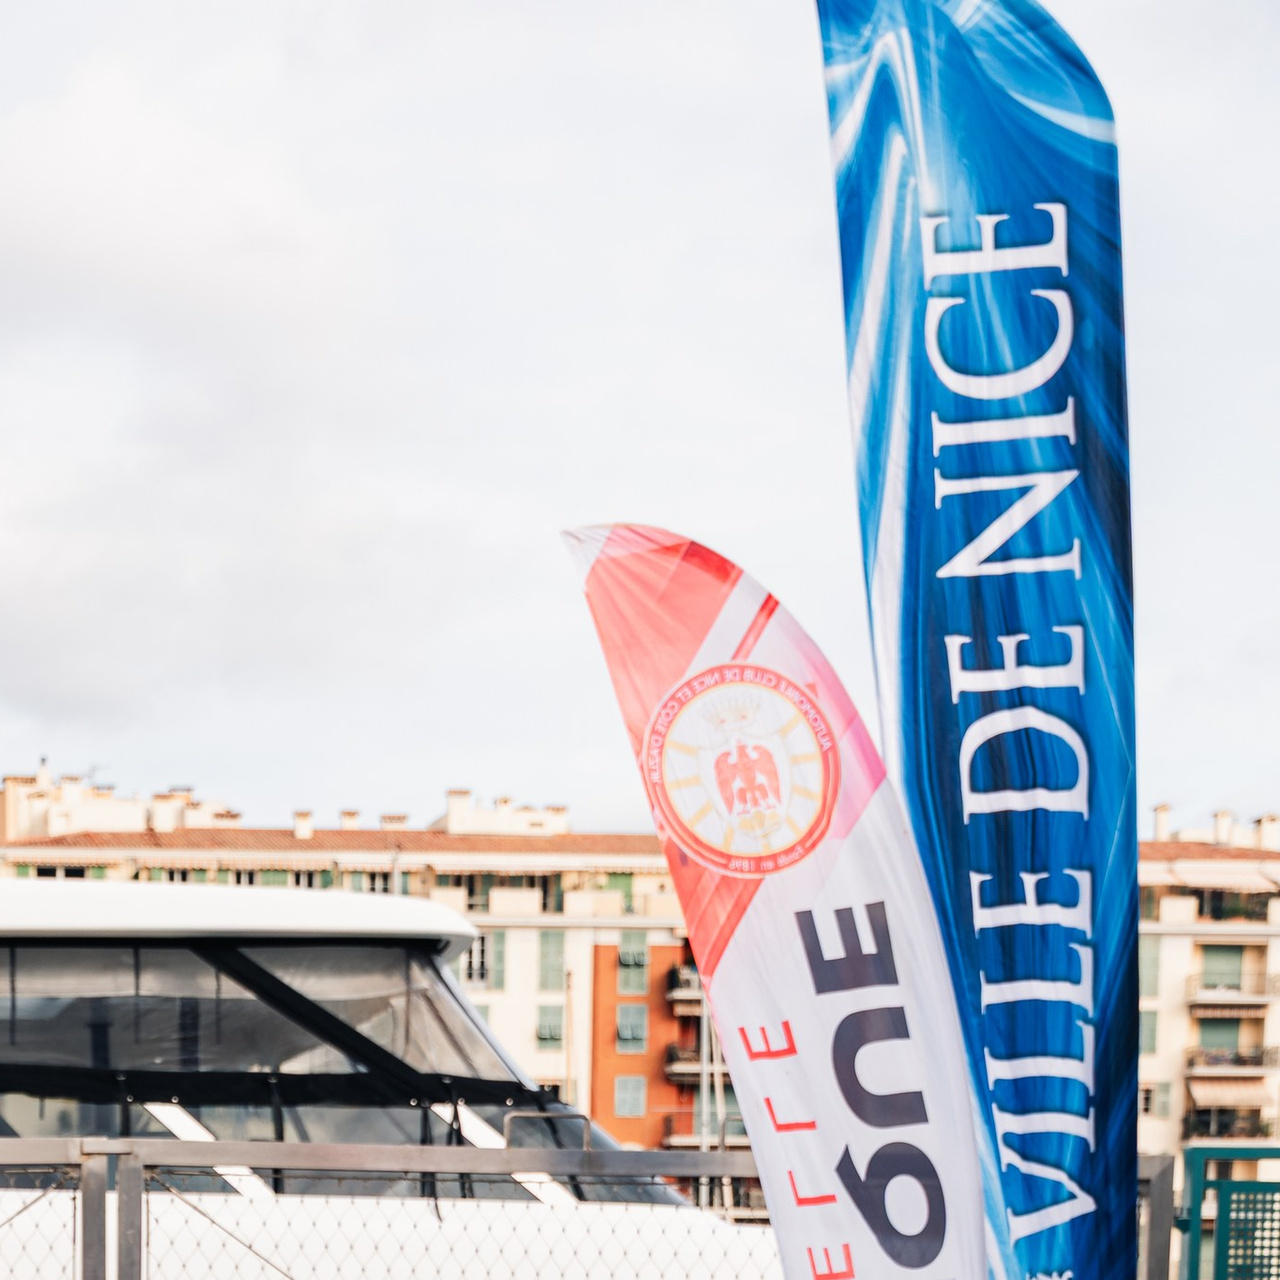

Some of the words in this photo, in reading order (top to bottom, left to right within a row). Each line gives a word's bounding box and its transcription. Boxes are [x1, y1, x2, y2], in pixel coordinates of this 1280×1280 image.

[922, 202, 1083, 581] NICE
[944, 623, 1091, 825] DE
[969, 867, 1098, 1243] VILLE
